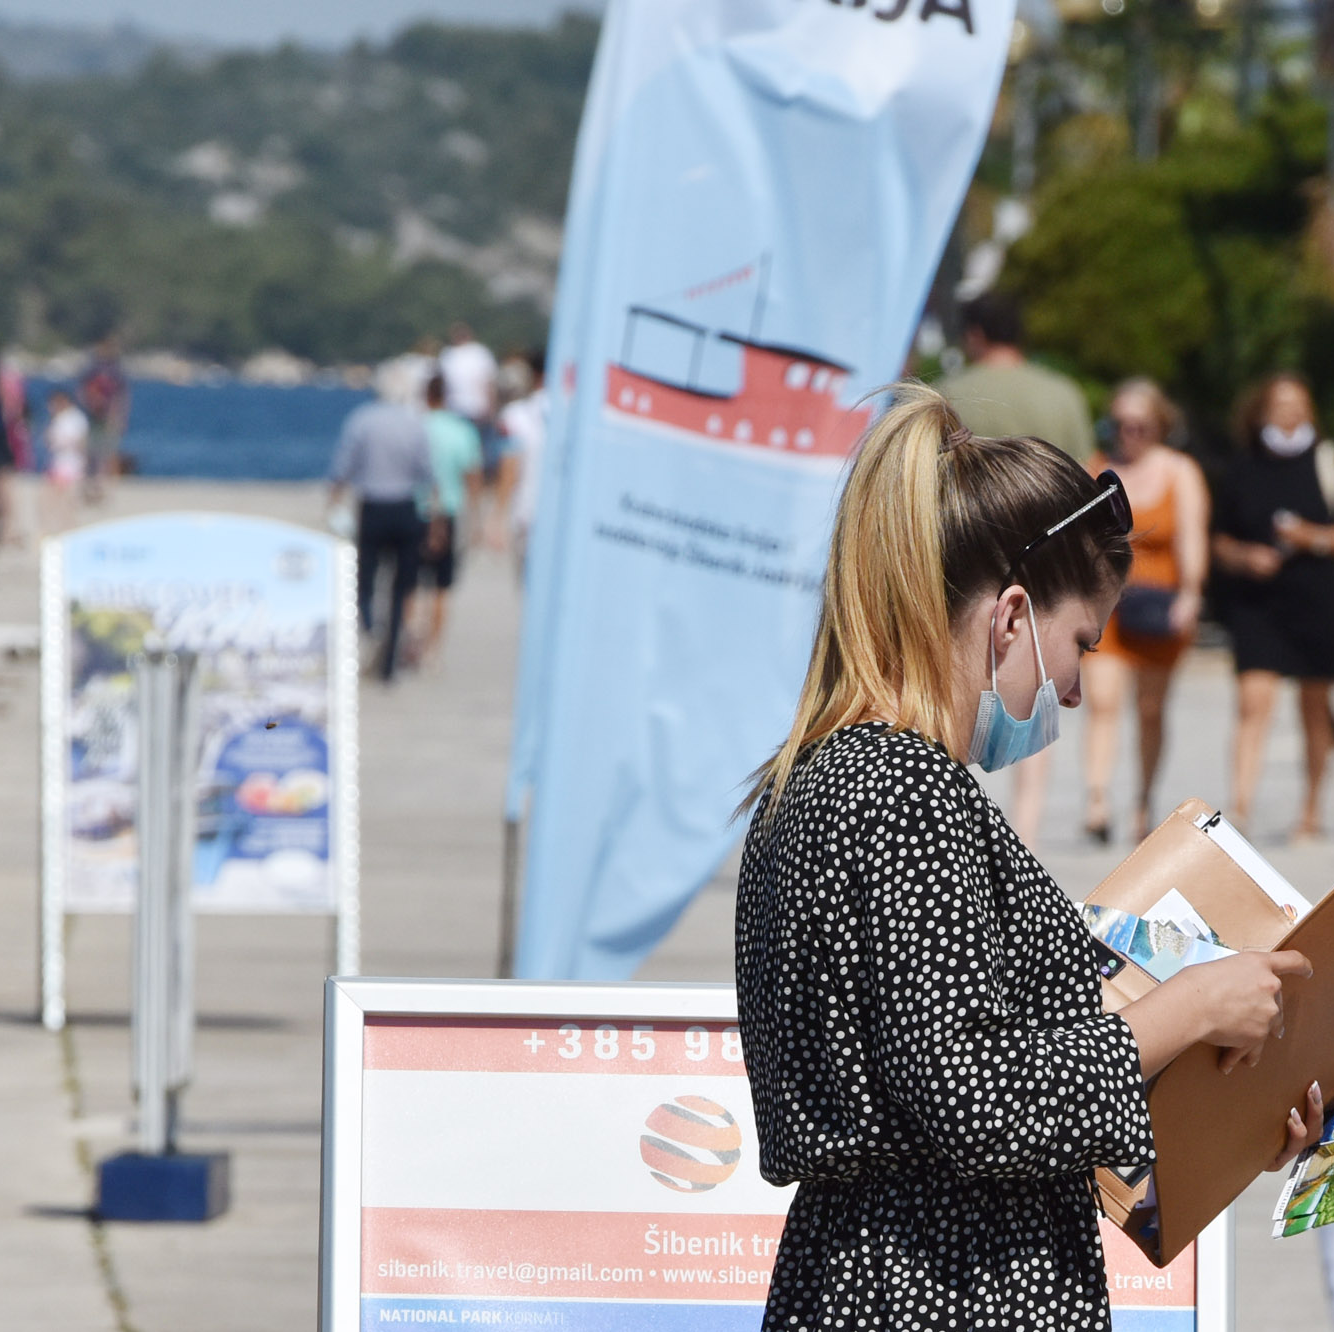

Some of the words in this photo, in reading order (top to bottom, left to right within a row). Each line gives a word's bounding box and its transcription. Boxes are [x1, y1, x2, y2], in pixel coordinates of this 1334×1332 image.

[523, 1024, 657, 1060] +385
[644, 1223, 744, 1256] Šibenik
[377, 1259, 642, 1284] sibenik.travel@gmail.com
[379, 1309, 457, 1323] NATIONAL
[461, 1310, 502, 1324] PARK
[505, 1310, 565, 1325] KORNATI
